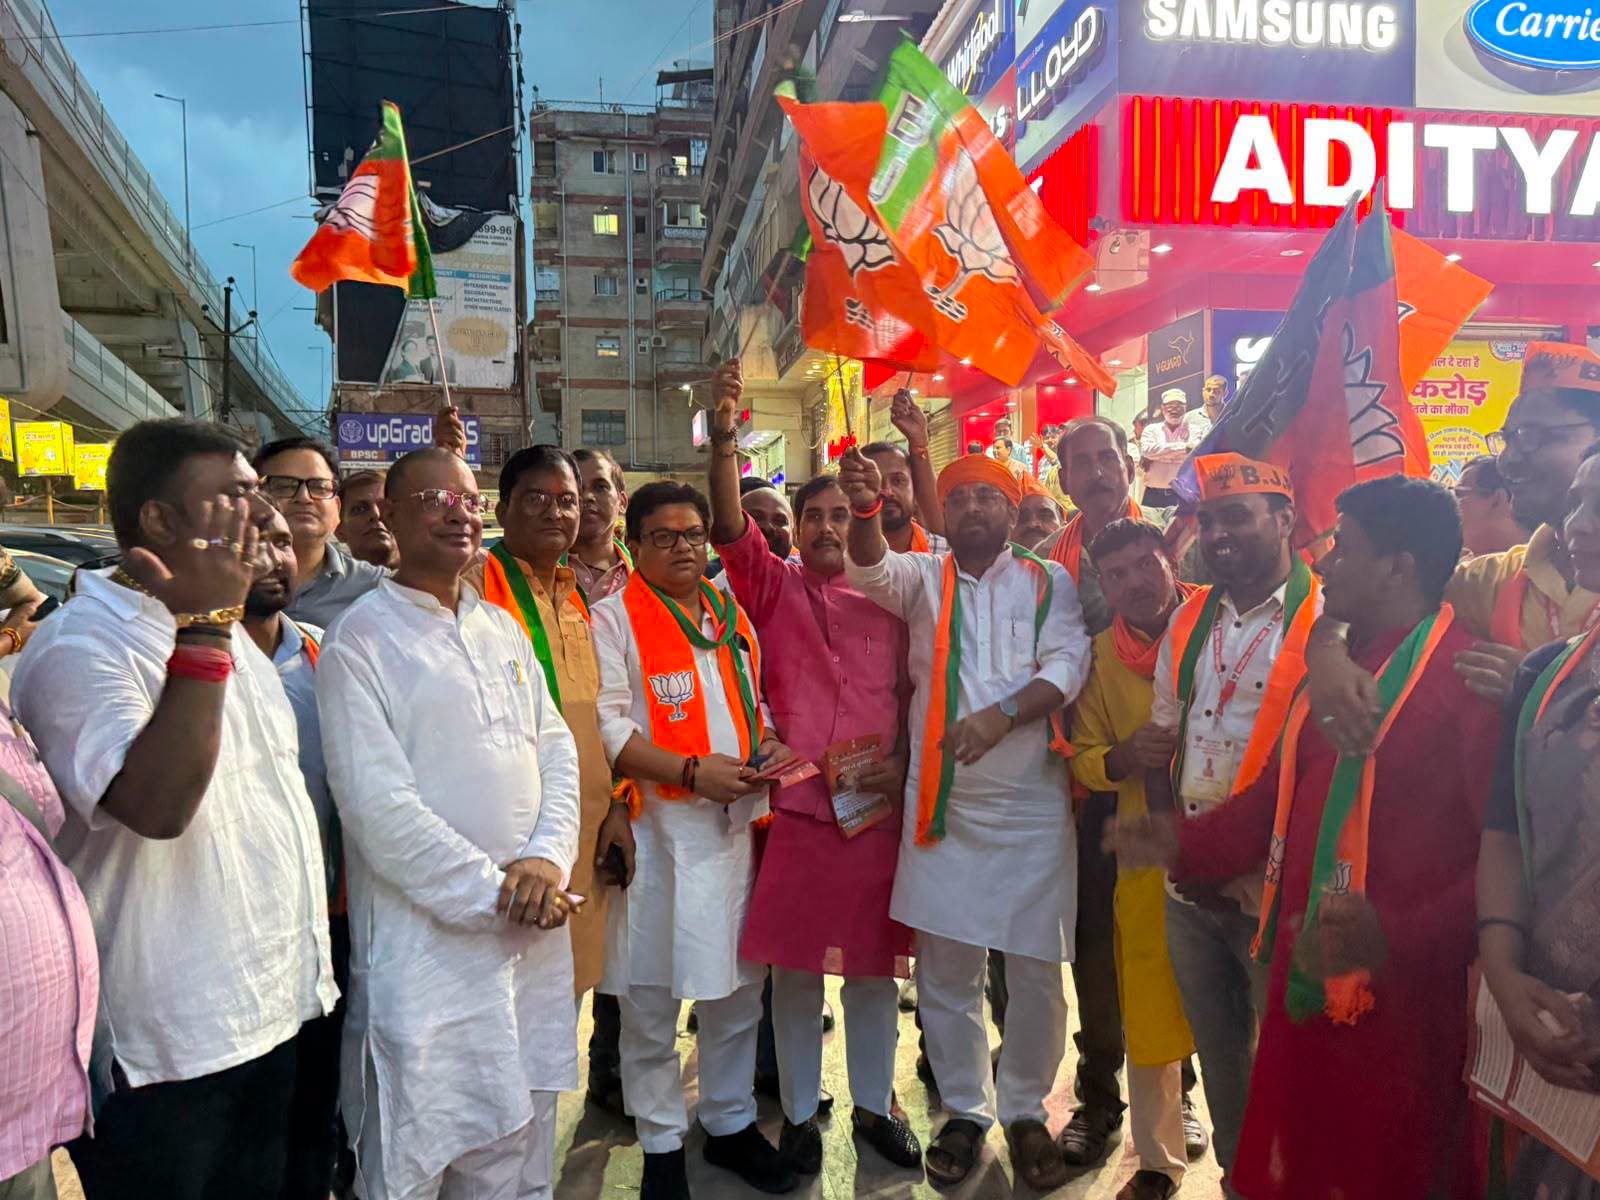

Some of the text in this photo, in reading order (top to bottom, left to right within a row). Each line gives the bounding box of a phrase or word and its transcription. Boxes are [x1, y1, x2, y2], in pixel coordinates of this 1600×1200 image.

[1147, 0, 1396, 48] SAMSUNG
[1495, 2, 1600, 42] Carrie
[947, 0, 999, 90] Whirlpool
[1016, 6, 1097, 121] LLOYD
[1411, 373, 1490, 407] करोड़
[1430, 405, 1443, 415] का
[366, 417, 433, 448] upGrad
[350, 450, 379, 459] BPSC
